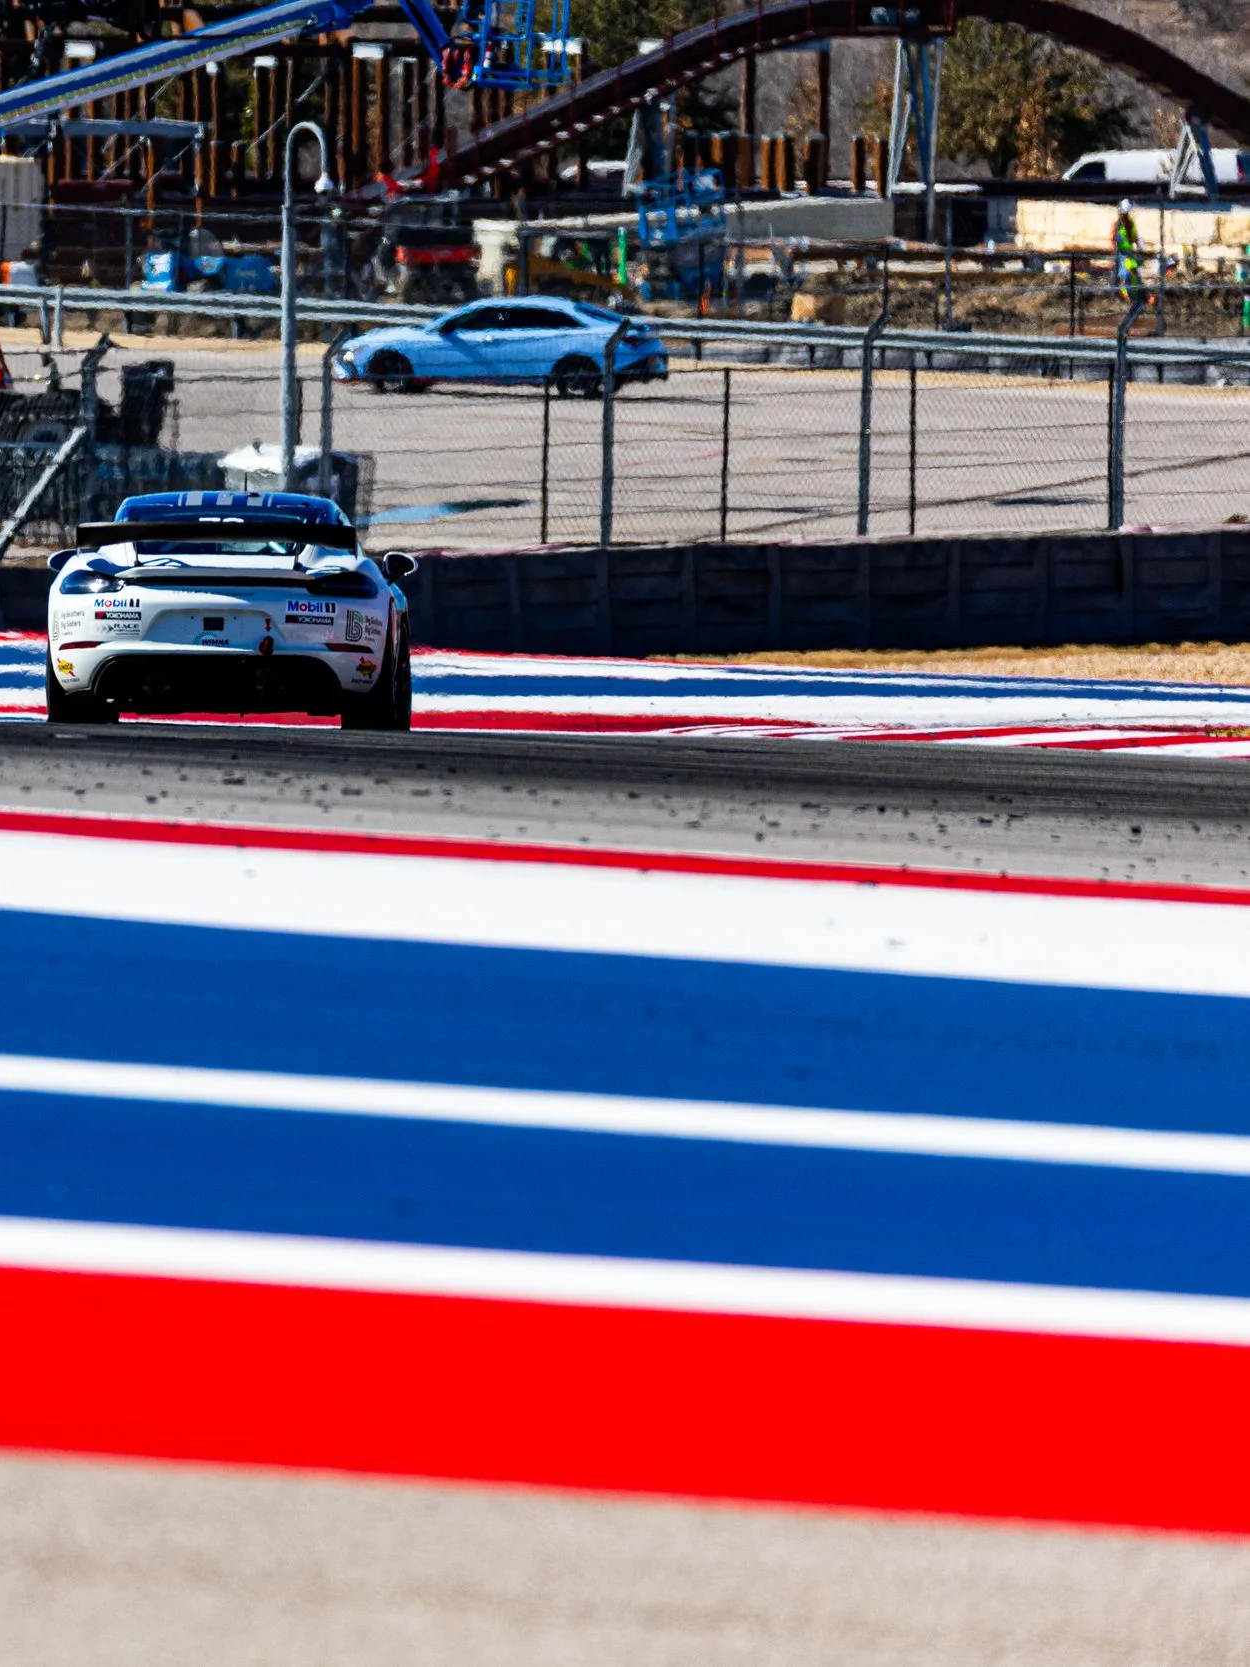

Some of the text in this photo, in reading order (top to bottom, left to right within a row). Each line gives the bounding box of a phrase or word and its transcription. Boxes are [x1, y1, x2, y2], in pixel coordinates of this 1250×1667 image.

[94, 598, 127, 608] Mobil
[287, 600, 323, 613] Mobil
[105, 612, 140, 620] YOKOHAMA
[298, 616, 332, 625] YOKOHAMA
